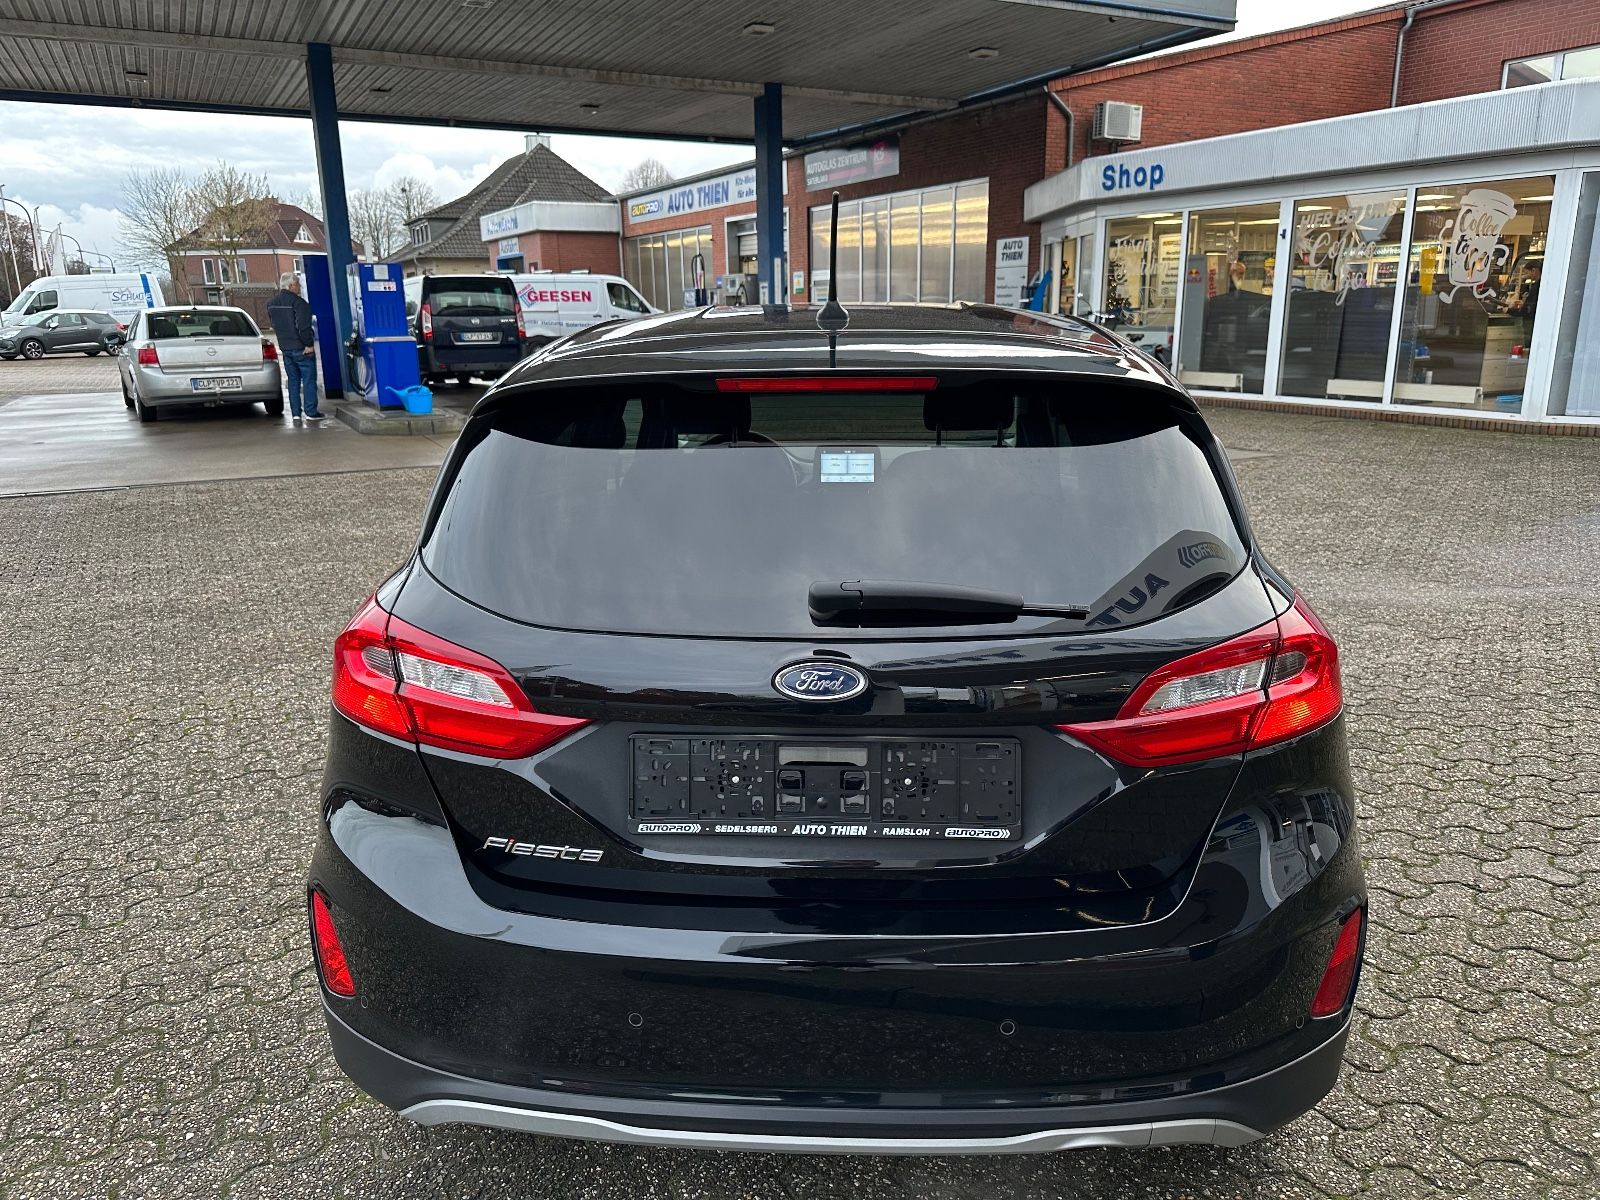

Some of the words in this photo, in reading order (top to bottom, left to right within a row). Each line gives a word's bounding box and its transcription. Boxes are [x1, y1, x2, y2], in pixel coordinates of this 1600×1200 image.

[806, 158, 837, 175] AUTOGLAS
[837, 150, 868, 168] ZENTRUM
[1102, 163, 1164, 191] Shop
[667, 188, 694, 214] AUTO
[697, 180, 729, 207] THIEN
[1300, 211, 1333, 226] HIER
[1459, 208, 1499, 235] Coffee
[1002, 240, 1024, 251] AUTO
[1309, 232, 1376, 276] Coffee
[1456, 235, 1473, 255] to
[1001, 251, 1024, 261] THIEN
[527, 290, 592, 302] GEESEN
[796, 671, 844, 691] Ford
[714, 825, 778, 834] SEDELSBERG
[791, 824, 828, 835] AUTO
[830, 825, 867, 836] THIEN
[882, 827, 930, 836] RAMSLOH
[483, 836, 604, 862] Fiesta
